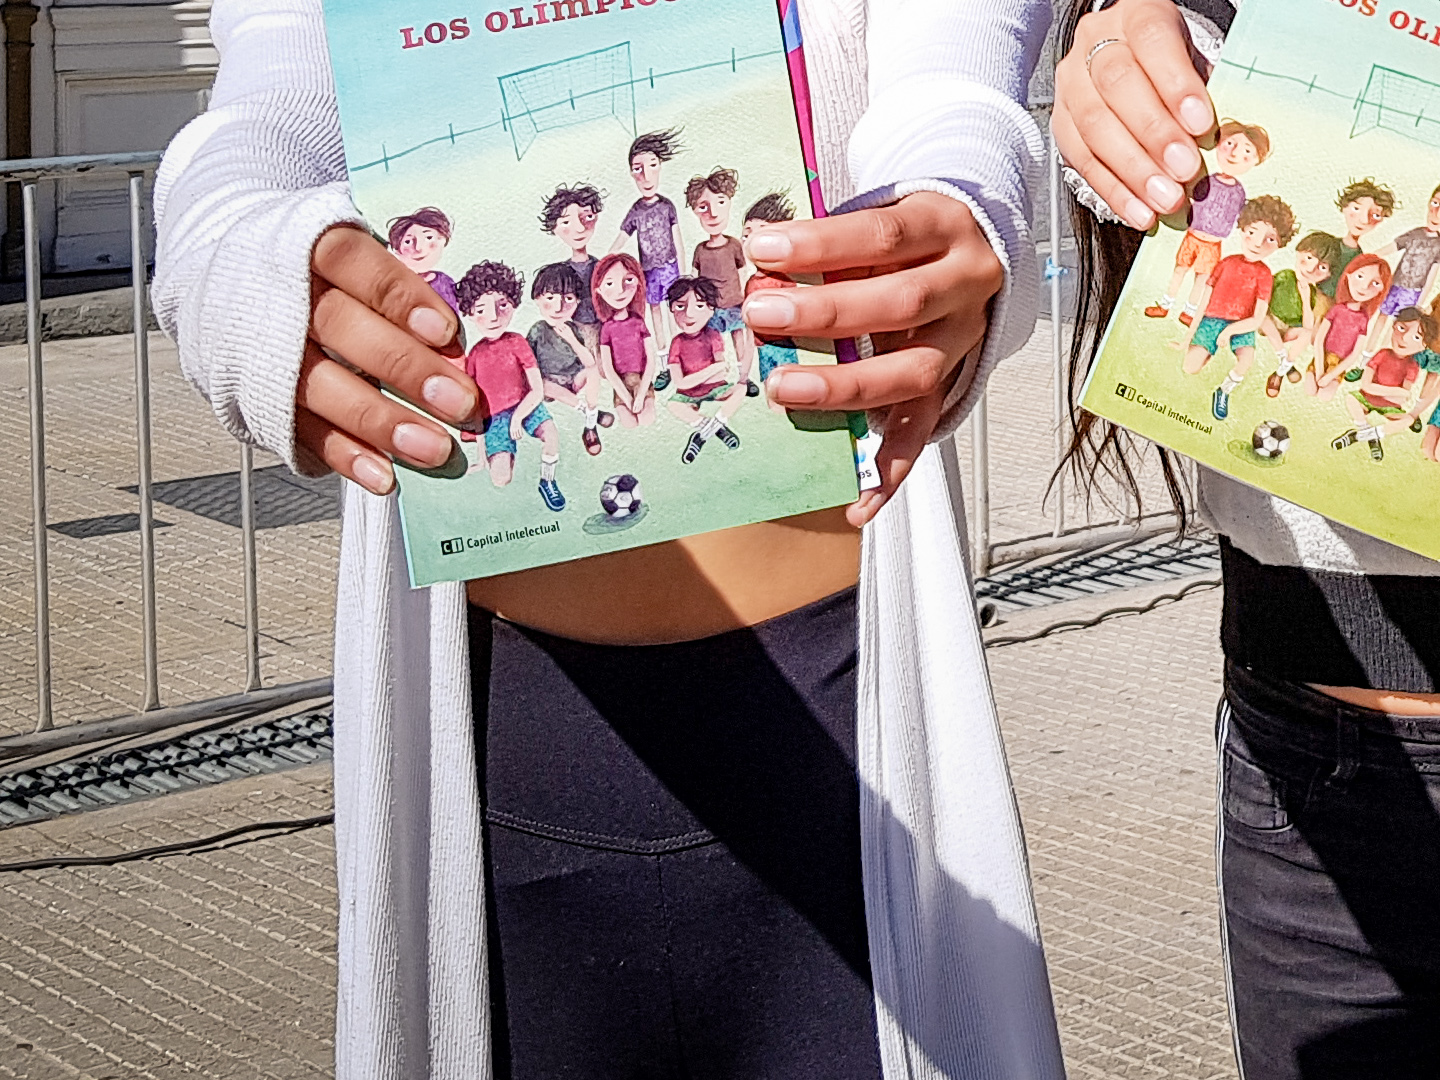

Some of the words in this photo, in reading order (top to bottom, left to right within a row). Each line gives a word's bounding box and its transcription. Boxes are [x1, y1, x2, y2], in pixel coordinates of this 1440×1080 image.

[400, 17, 471, 49] LOS
[1136, 394, 1167, 415] Capital
[466, 532, 503, 549] Capital
